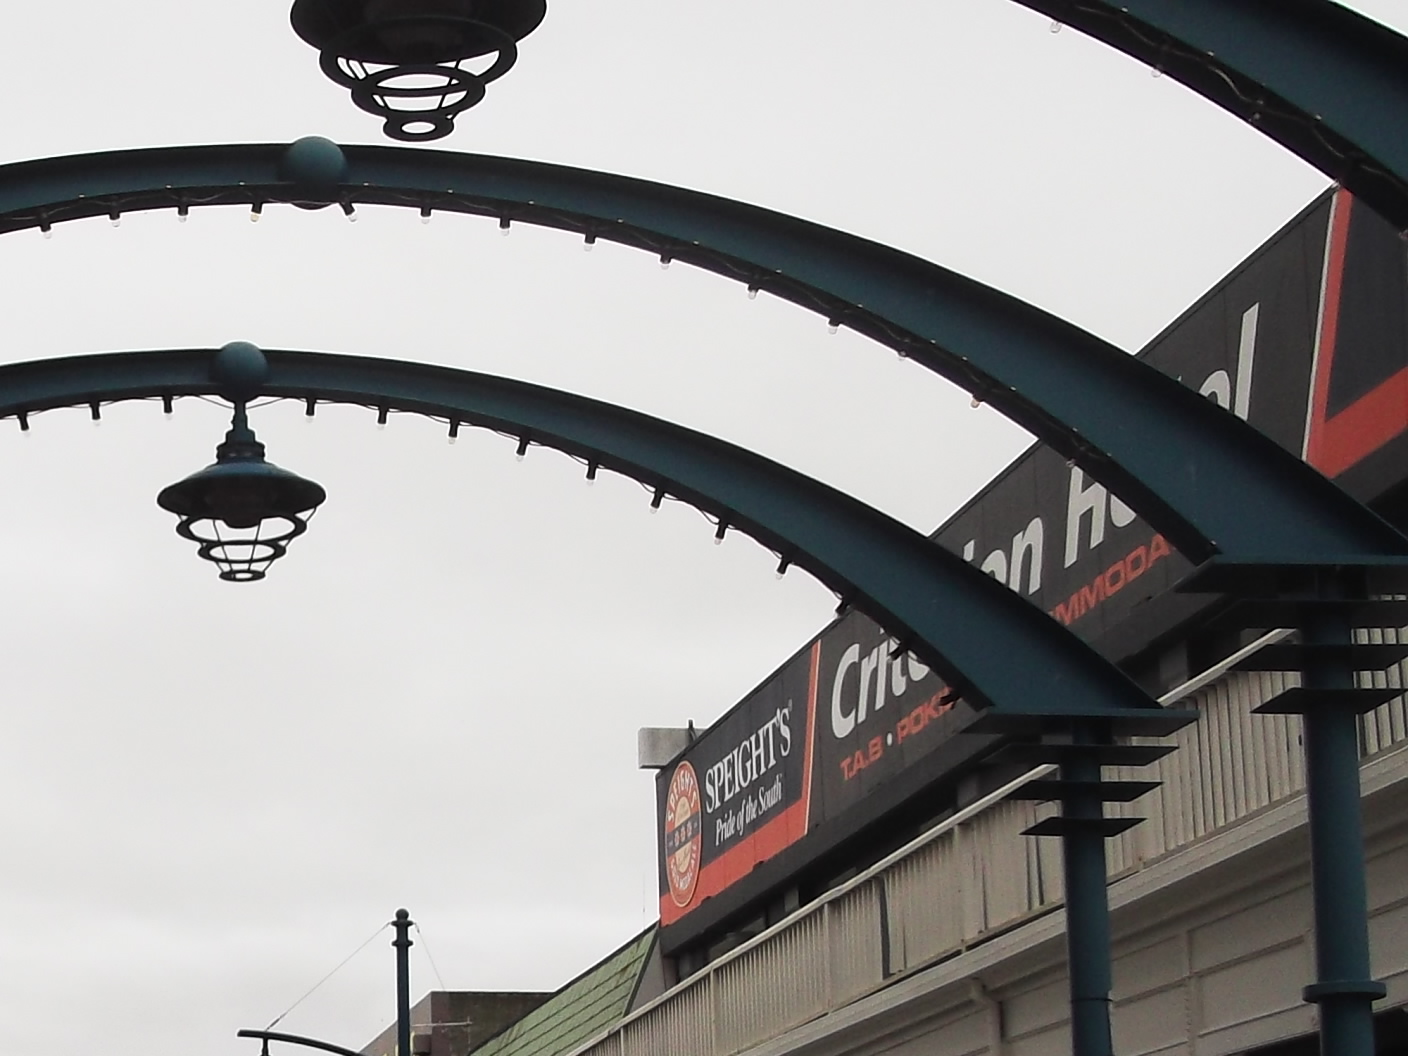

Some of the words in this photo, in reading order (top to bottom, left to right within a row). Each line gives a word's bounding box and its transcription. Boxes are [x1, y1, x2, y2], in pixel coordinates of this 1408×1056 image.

[705, 706, 791, 814] SPEIGHT'S
[716, 809, 736, 846] Pride
[737, 799, 746, 836] of
[746, 795, 758, 824] the
[758, 774, 782, 816] South
